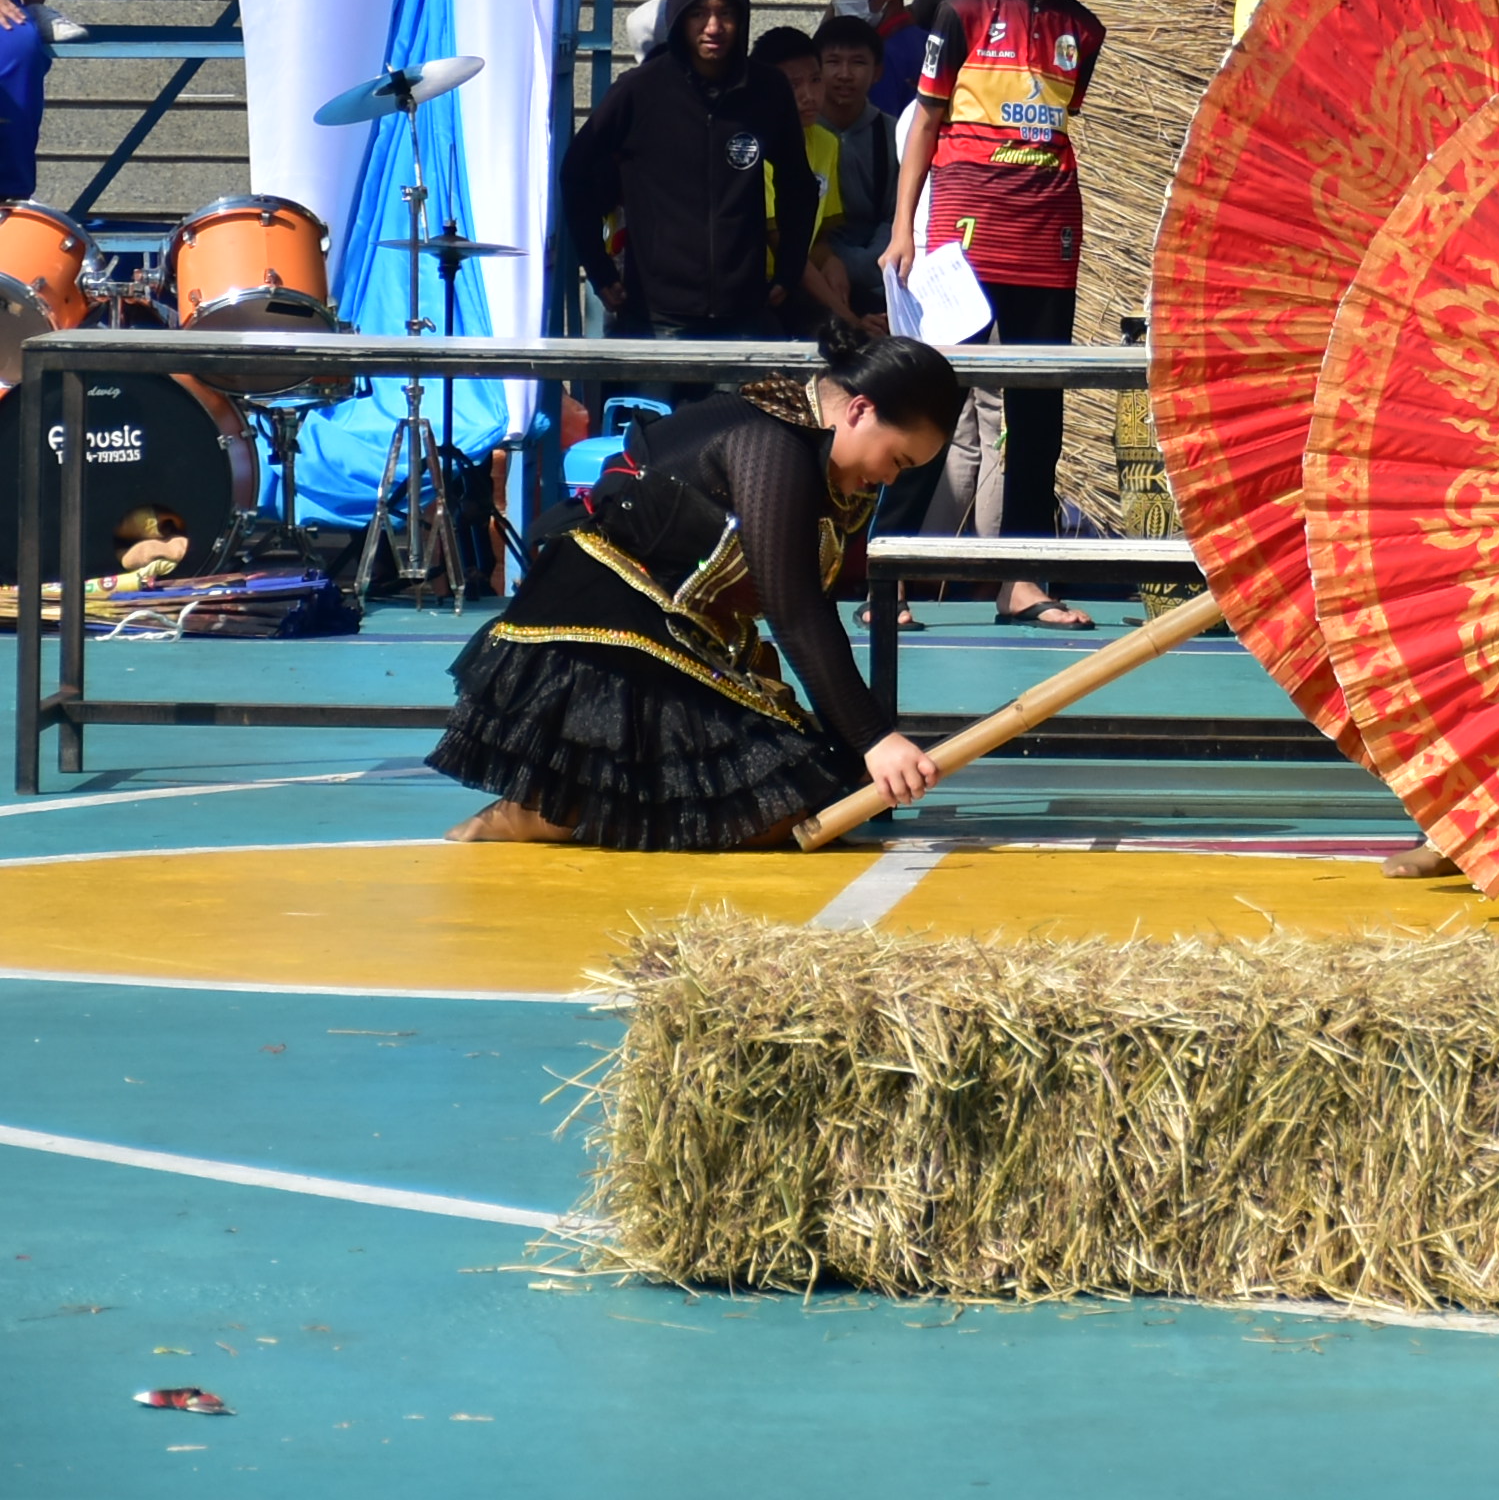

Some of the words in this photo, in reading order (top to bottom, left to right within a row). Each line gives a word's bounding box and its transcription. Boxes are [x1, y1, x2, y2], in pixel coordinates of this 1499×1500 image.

[977, 49, 1016, 59] THAILAND
[1001, 102, 1063, 127] SBOBET
[1020, 125, 1051, 142] 888
[86, 386, 121, 399] dwig
